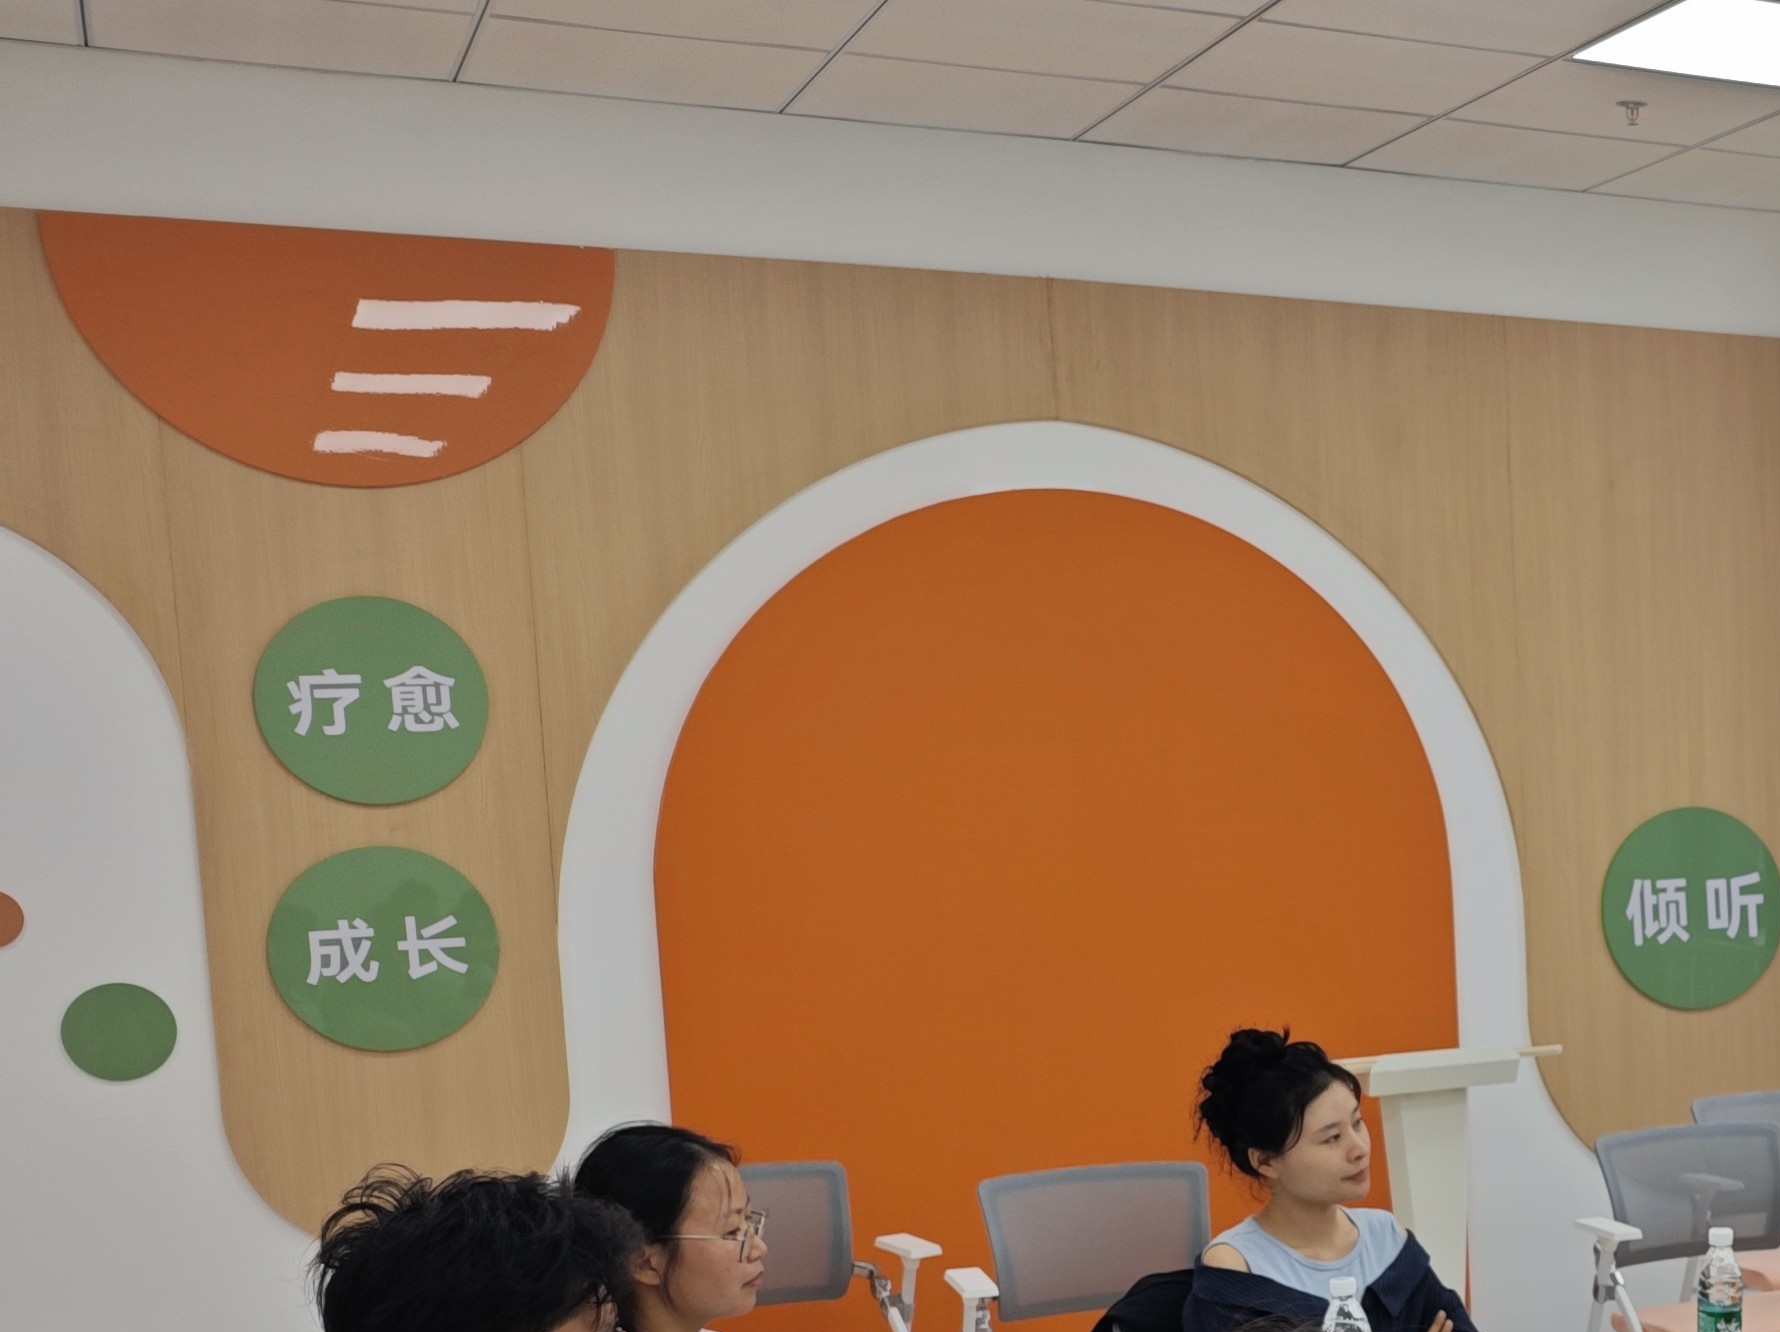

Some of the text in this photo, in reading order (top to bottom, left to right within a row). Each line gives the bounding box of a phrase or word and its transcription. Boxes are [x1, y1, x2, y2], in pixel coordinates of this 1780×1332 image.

[287, 665, 461, 736] 疗愈
[1625, 871, 1765, 947] 倾听
[306, 915, 469, 986] 成长
